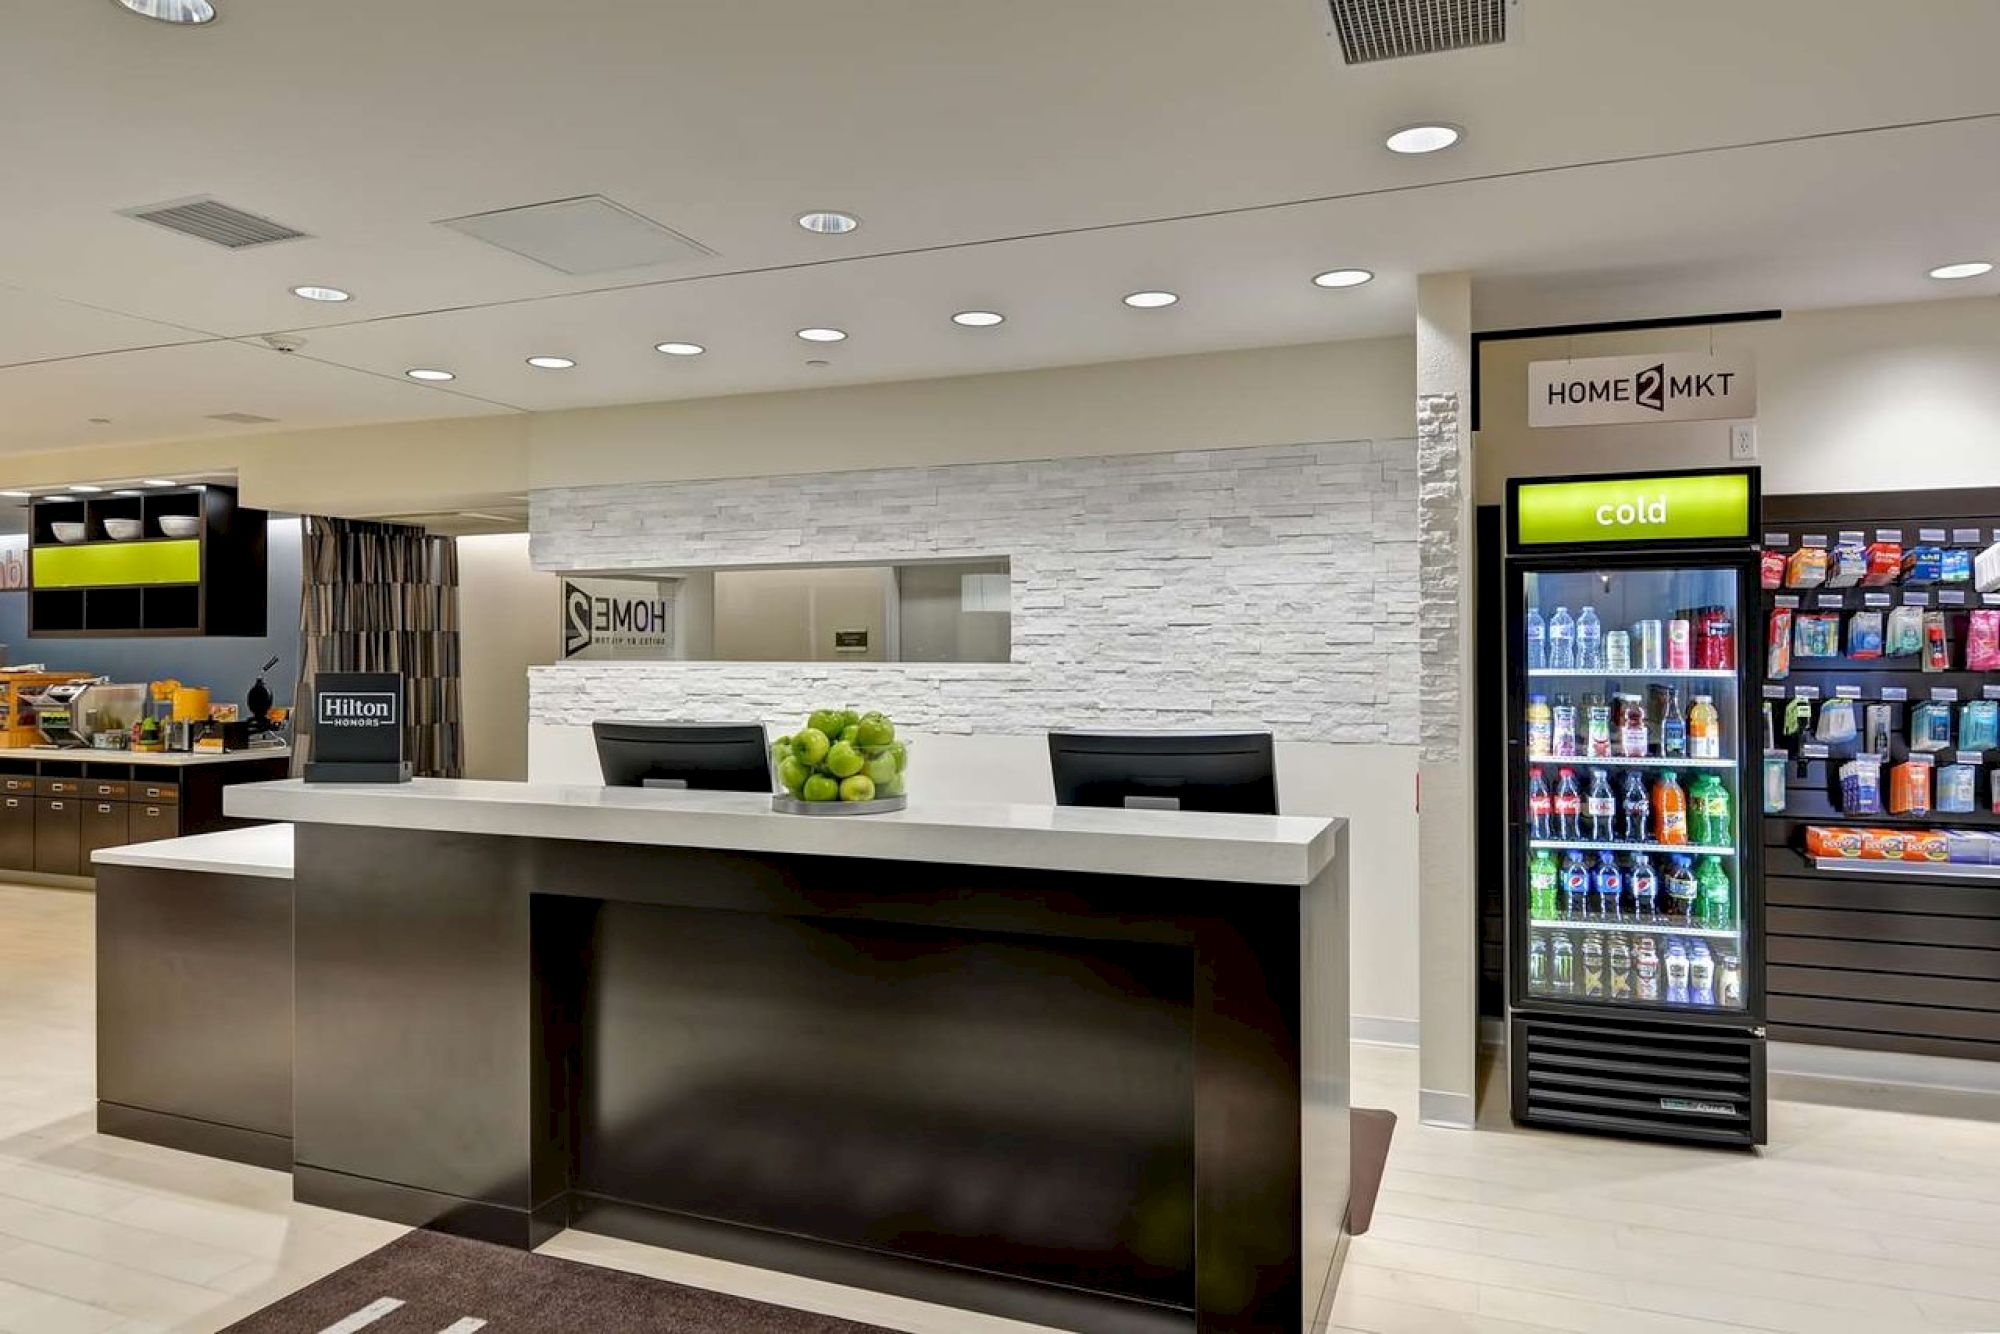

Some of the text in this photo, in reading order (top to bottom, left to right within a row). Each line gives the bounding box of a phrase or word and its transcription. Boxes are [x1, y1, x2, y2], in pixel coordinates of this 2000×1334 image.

[1548, 378, 1630, 405] HOME
[1670, 373, 1735, 398] MKT
[1596, 494, 1667, 526] cold
[325, 698, 389, 717] Hilton
[334, 718, 379, 728] HONORS
